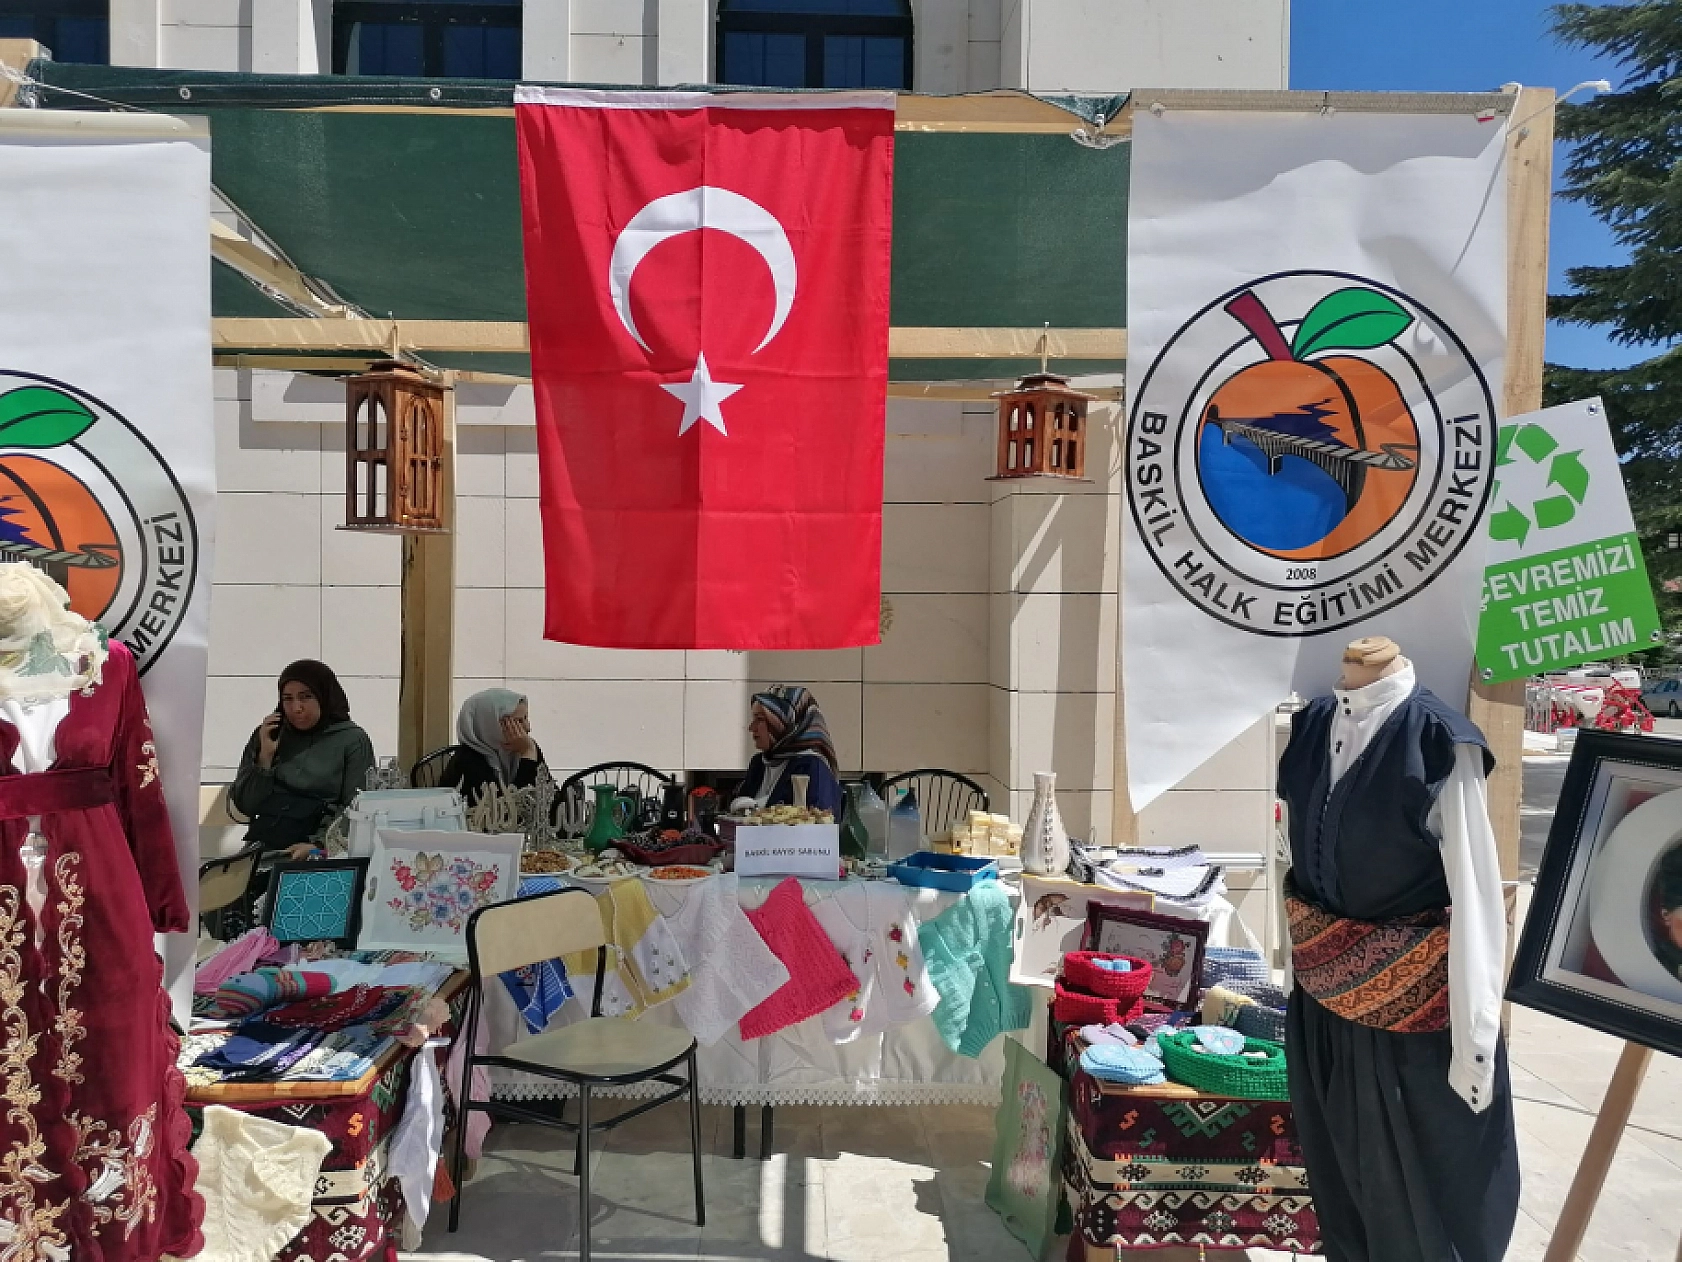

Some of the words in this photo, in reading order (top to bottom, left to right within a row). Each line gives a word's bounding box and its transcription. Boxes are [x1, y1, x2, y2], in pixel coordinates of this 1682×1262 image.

[1137, 410, 1178, 548] BASKİL
[1173, 550, 1258, 620] HALK
[1273, 563, 1404, 626] EĞİTİMİ
[1404, 413, 1482, 572] MERKEZİ
[123, 511, 185, 661] MERKEZİ
[1285, 567, 1317, 580] 2008
[1511, 585, 1609, 631] TEMİZ
[1501, 617, 1637, 670] TUTALIM
